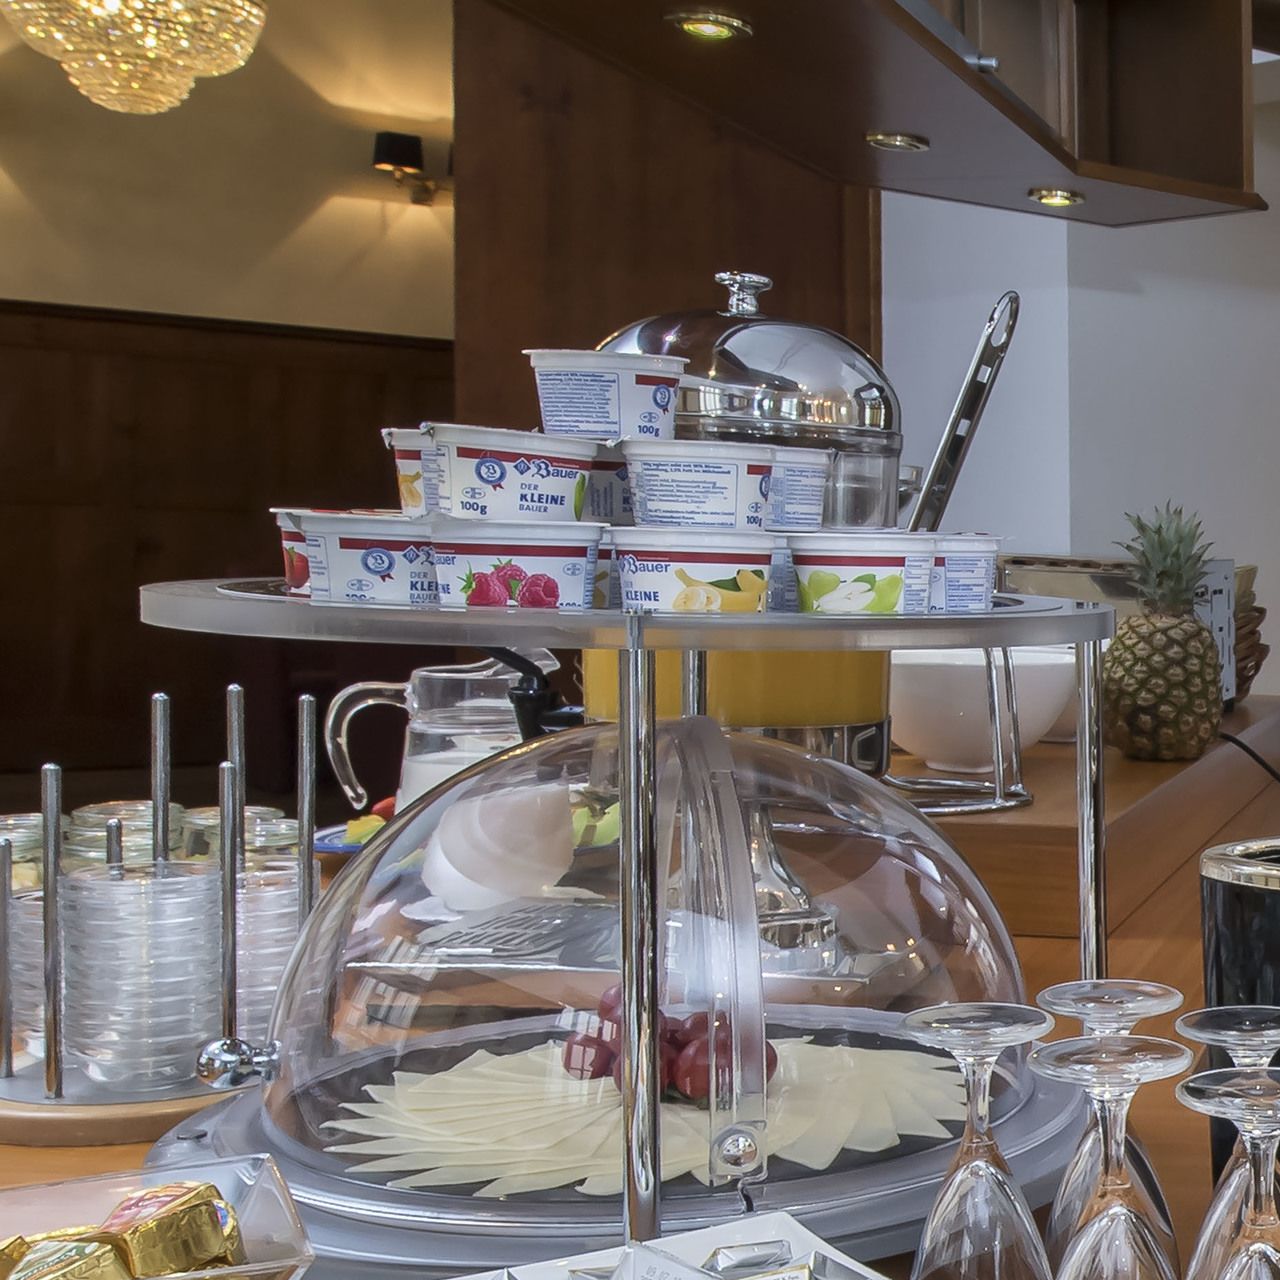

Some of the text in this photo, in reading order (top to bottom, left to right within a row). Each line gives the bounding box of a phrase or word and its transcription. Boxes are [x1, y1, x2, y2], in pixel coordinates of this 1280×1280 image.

[637, 424, 660, 438] 100g
[532, 459, 579, 480] Bauer
[520, 482, 539, 492] DER
[519, 493, 566, 506] KLEINE
[460, 500, 488, 515] 100g
[518, 504, 549, 513] BAUER
